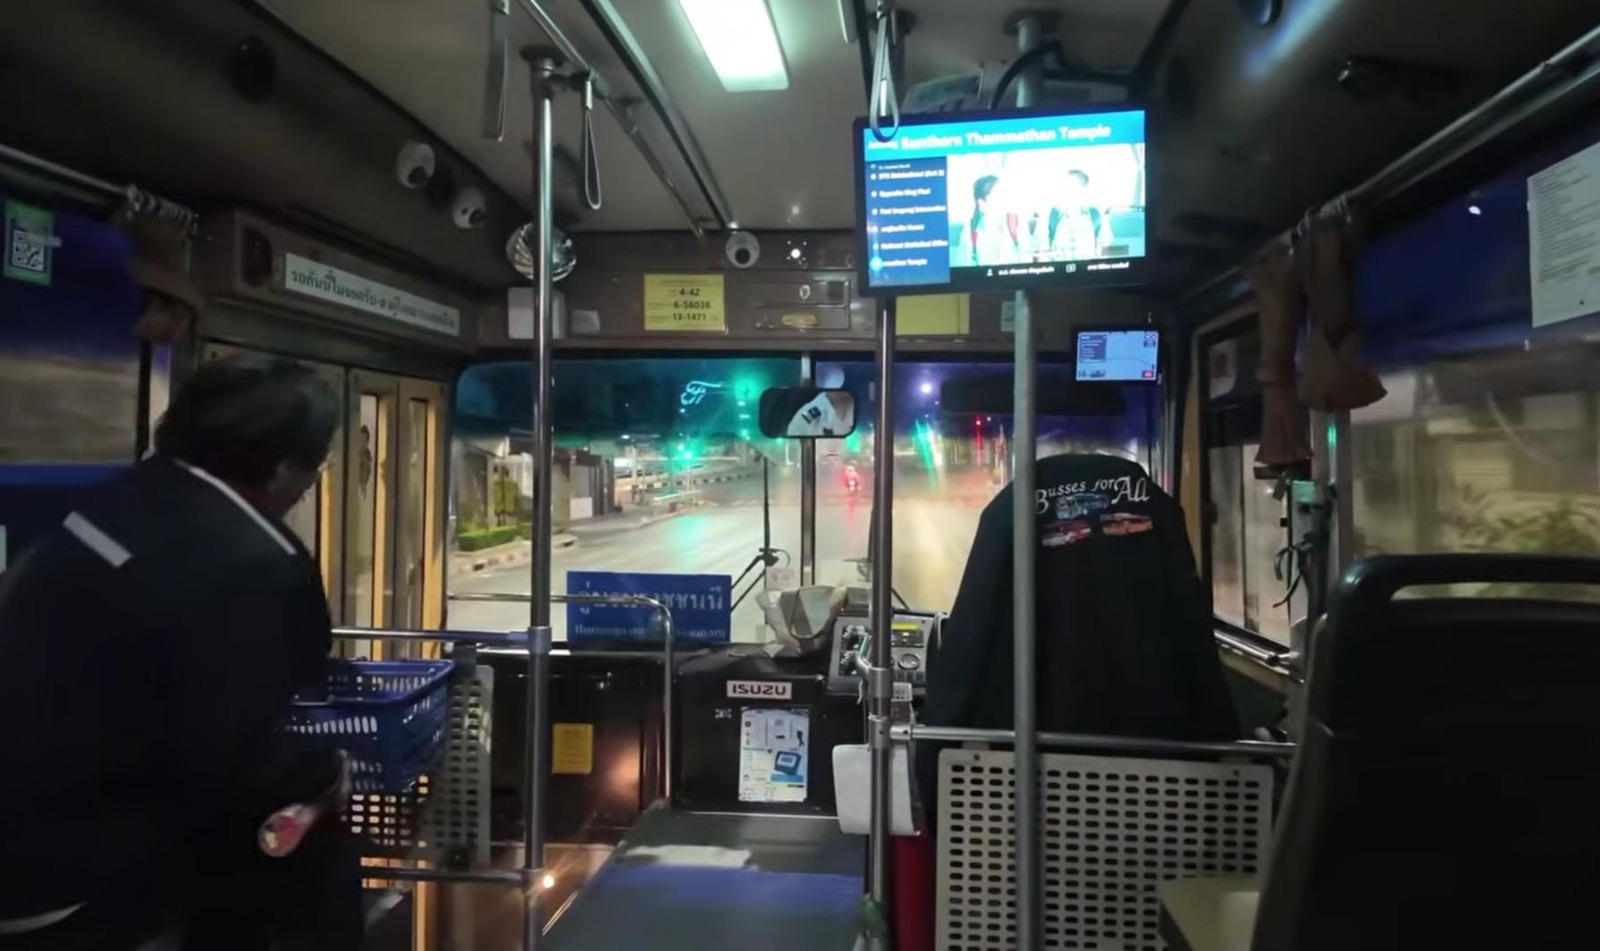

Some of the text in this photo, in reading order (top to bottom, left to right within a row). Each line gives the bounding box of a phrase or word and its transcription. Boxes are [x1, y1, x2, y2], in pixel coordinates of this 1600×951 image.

[1059, 124, 1111, 141] Temple
[679, 288, 700, 297] 4-42
[1034, 476, 1151, 515] Busses for All
[732, 684, 787, 696] ISUZU
